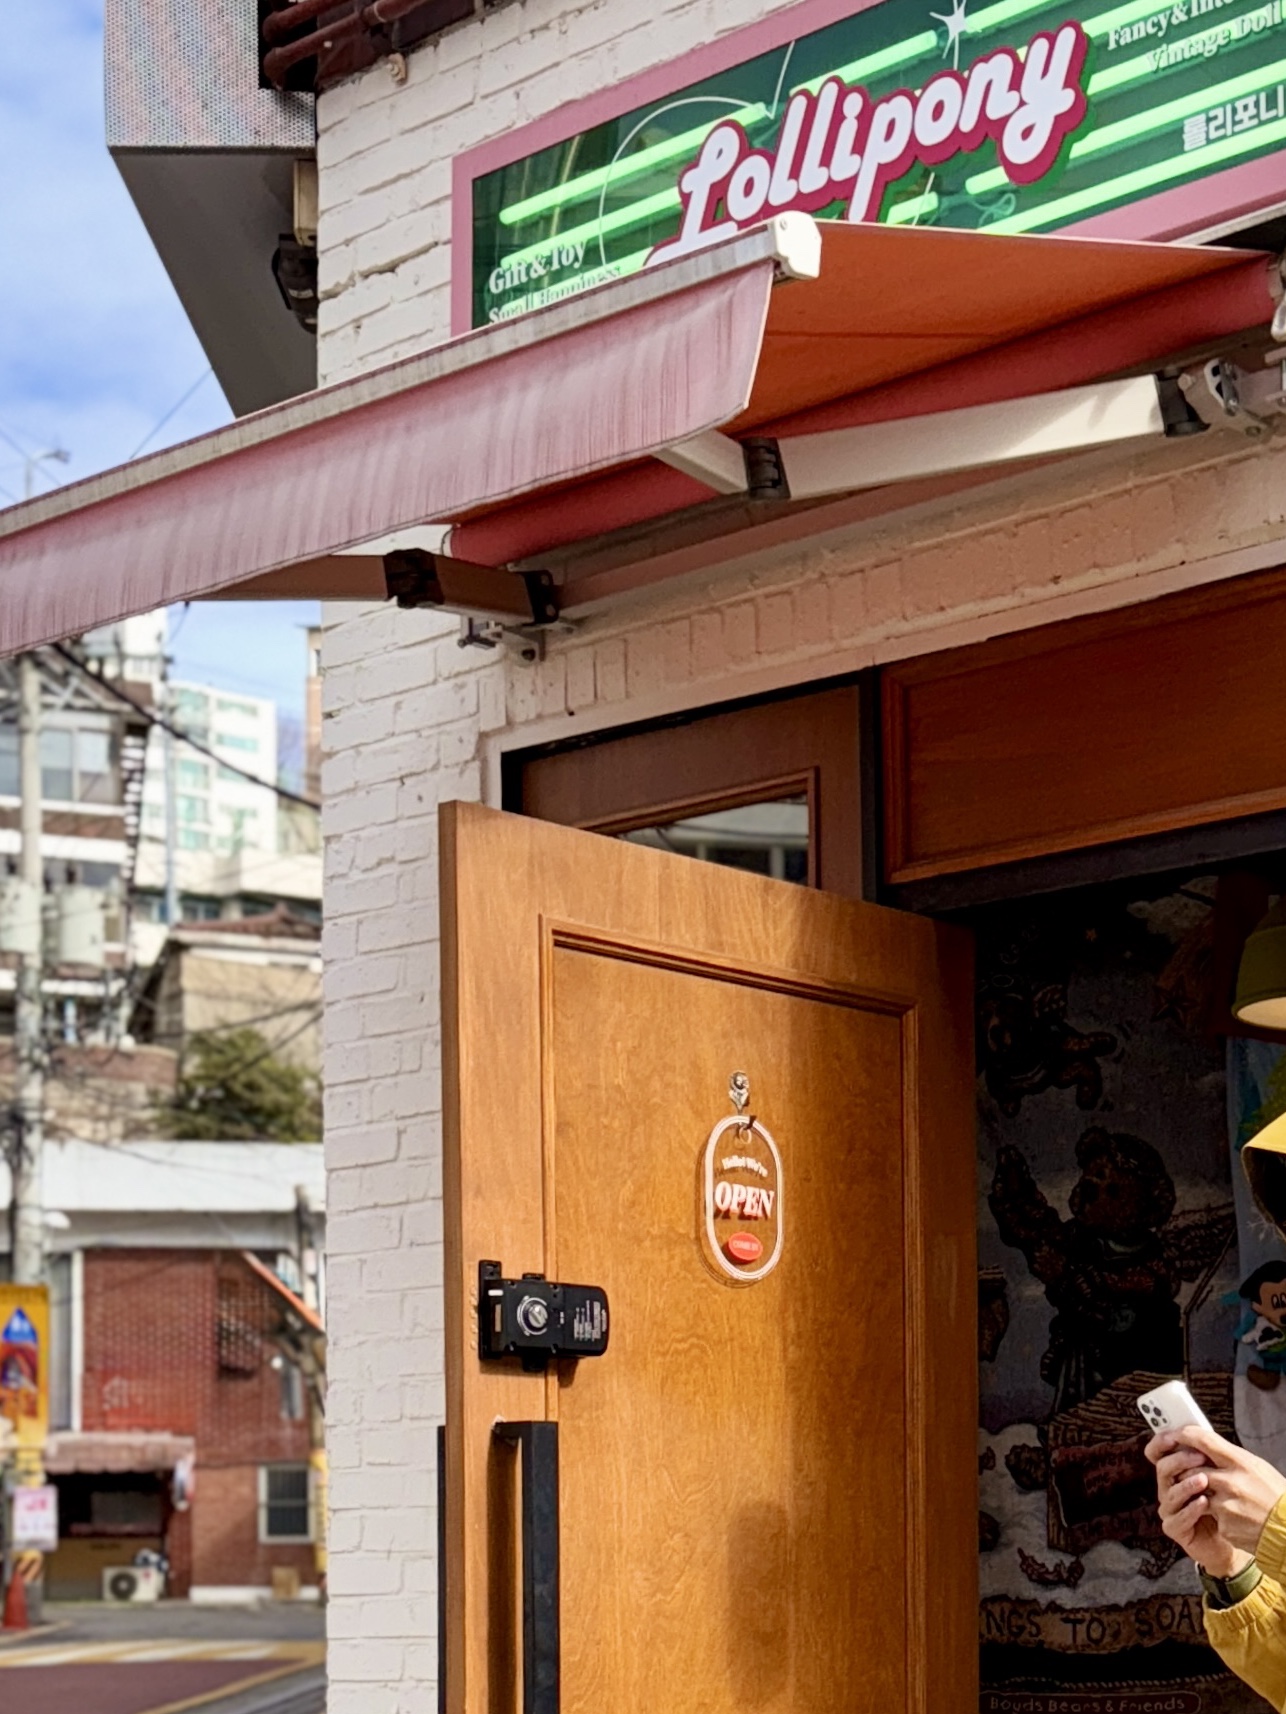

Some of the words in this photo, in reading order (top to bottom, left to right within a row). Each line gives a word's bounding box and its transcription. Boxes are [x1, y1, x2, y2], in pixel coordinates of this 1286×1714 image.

[1147, 29, 1231, 72] Vintage
[1233, 1, 1282, 40] Doll
[1182, 84, 1285, 152] 롤리포니
[643, 23, 1083, 268] Lollipony
[714, 1181, 775, 1219] OPEN
[1134, 1599, 1206, 1638] SOA
[1047, 1697, 1102, 1714] Bears
[1104, 1697, 1114, 1713] &
[1118, 1696, 1186, 1714] Friends
